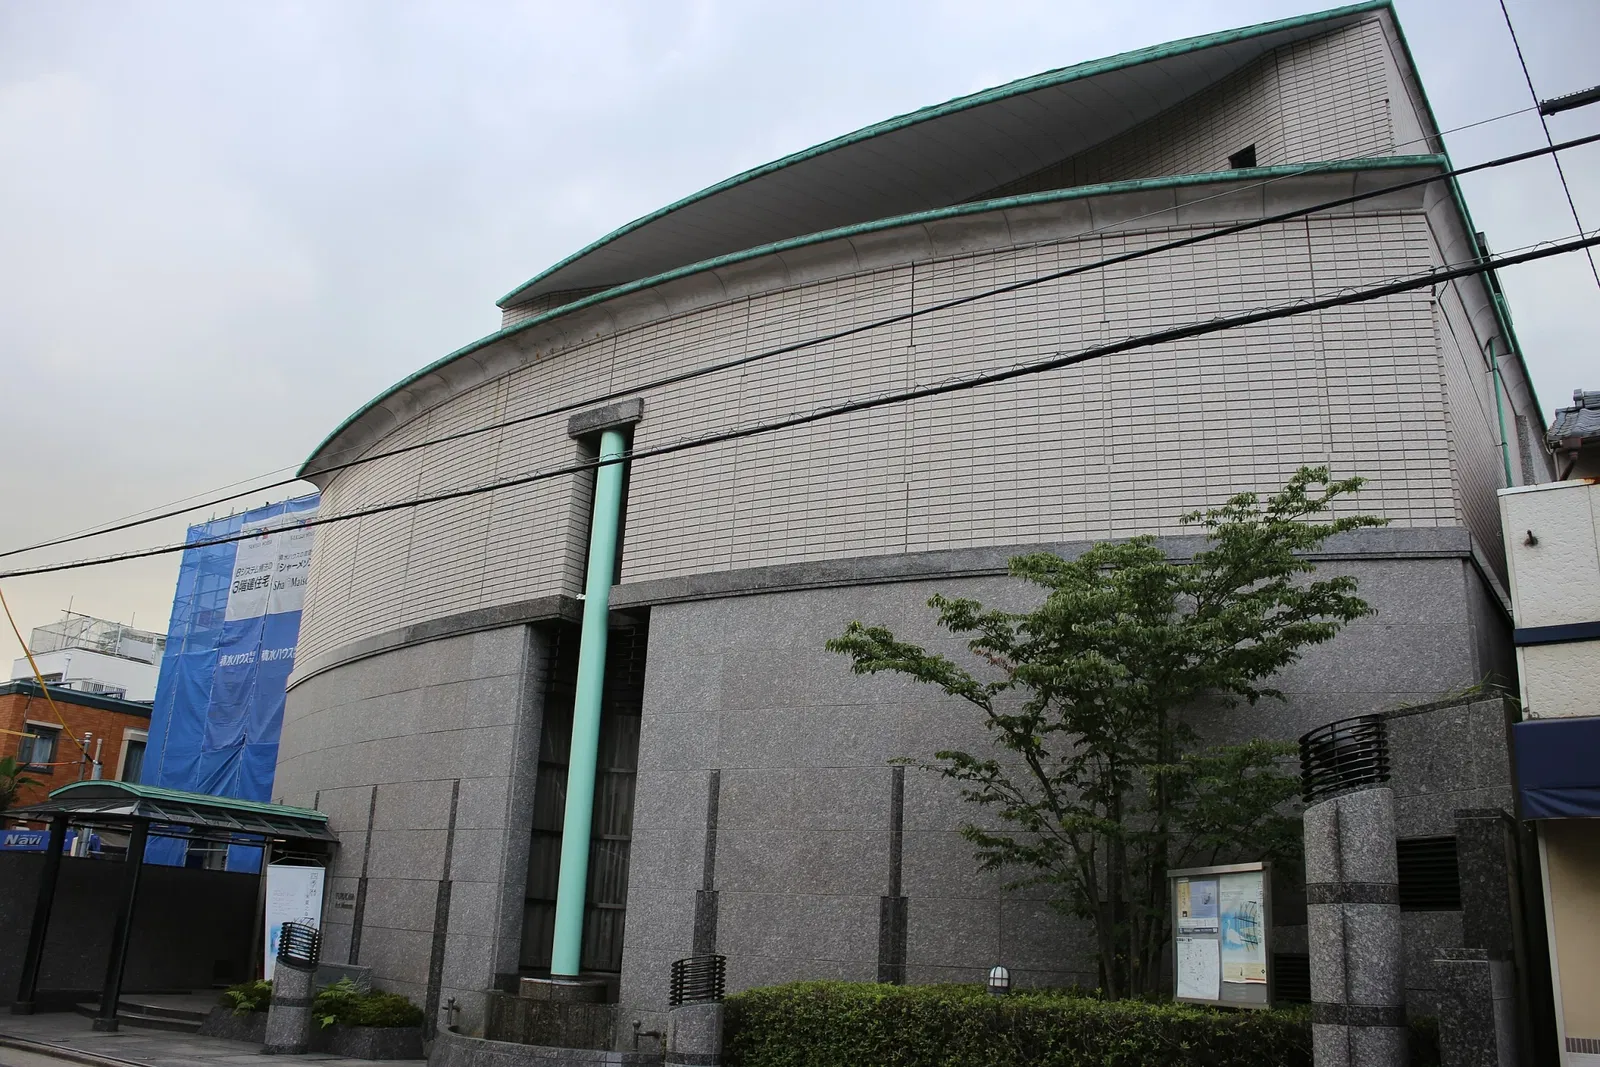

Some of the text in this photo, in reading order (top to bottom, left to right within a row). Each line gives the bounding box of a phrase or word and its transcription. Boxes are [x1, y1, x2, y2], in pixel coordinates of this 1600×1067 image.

[232, 574, 271, 594] 3階建住宅
[4, 834, 42, 845] Navi
